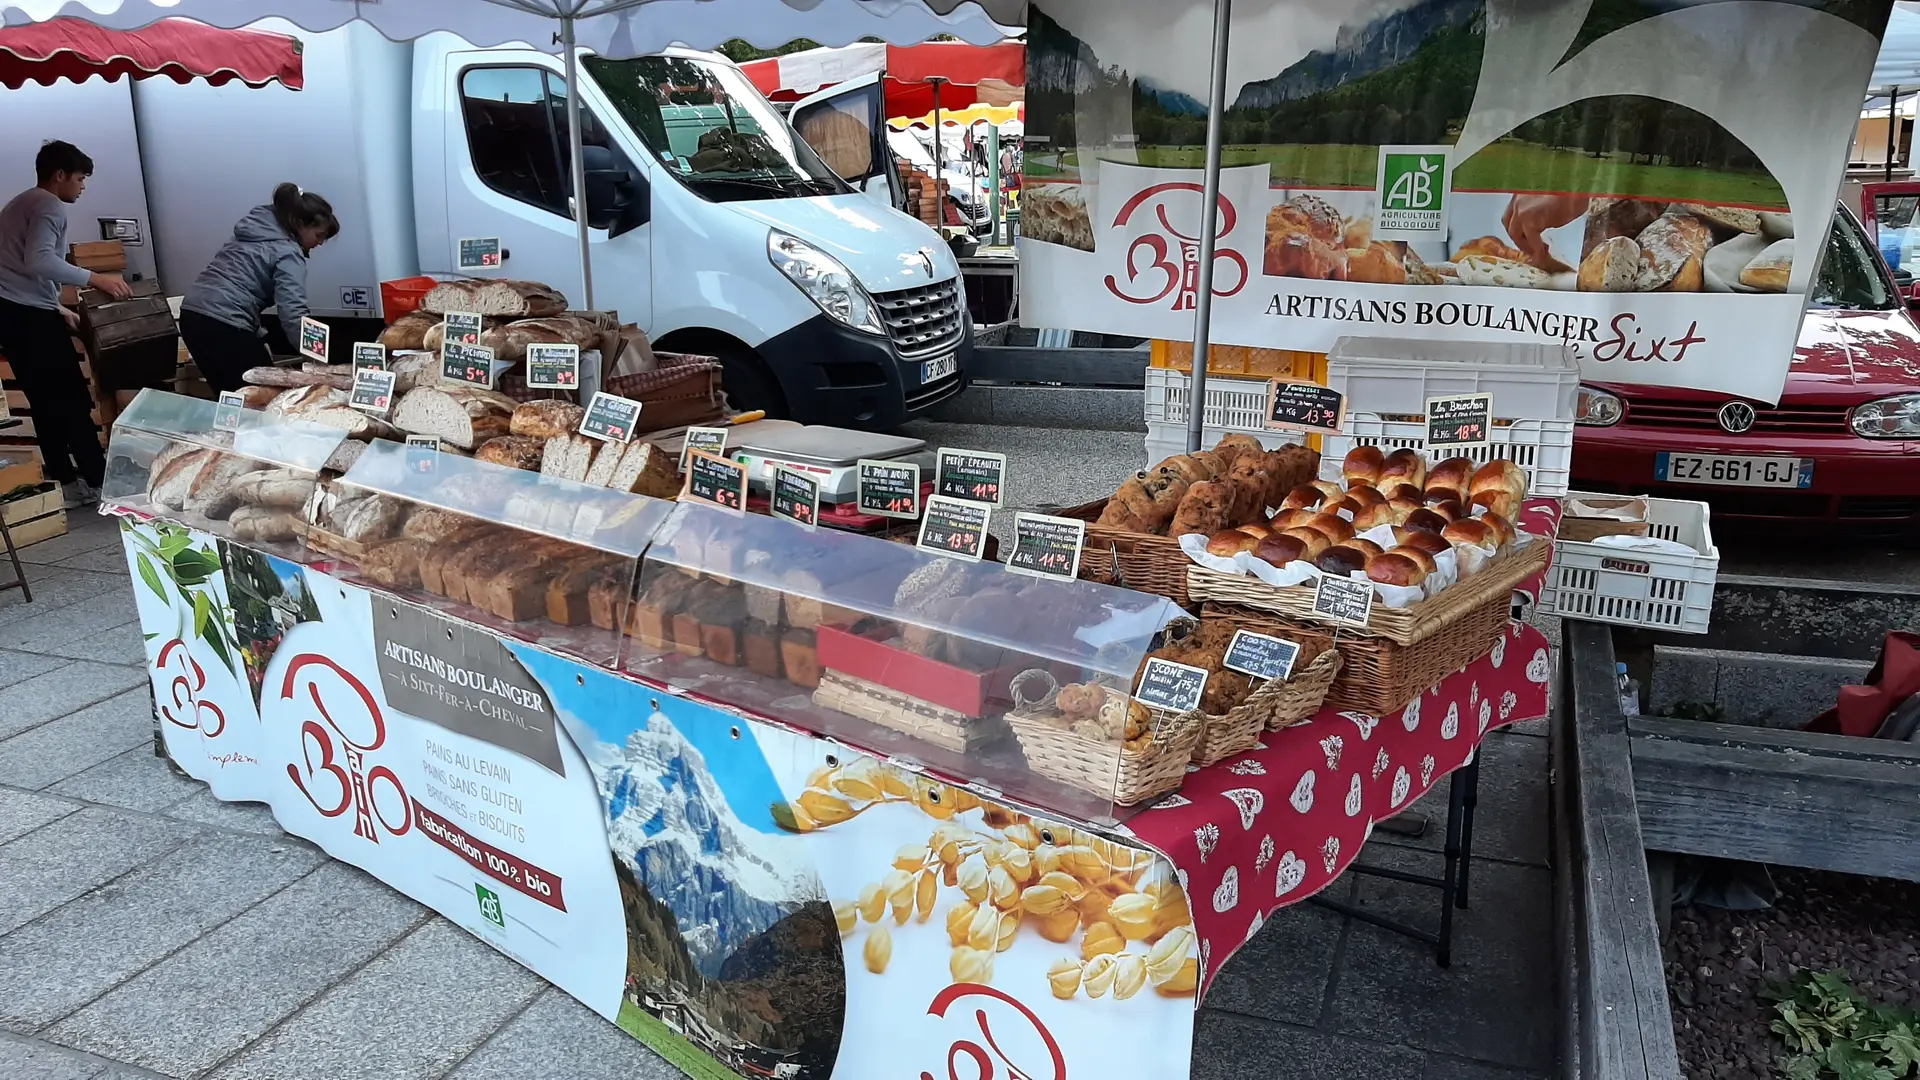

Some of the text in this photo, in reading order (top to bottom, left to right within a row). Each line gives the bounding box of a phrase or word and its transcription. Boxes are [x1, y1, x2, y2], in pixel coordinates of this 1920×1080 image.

[1386, 171, 1433, 207] AB
[1380, 220, 1440, 229] BIOLOGIQUE
[1381, 211, 1441, 220] AGRICULTURE
[1264, 293, 1600, 342] ARTISANS BOULANGER
[1593, 312, 1706, 362] Sixt
[1673, 457, 1794, 484] EZ-661-GJ
[1798, 473, 1811, 485] 74
[384, 639, 545, 713] ARTISANS BOULANGER
[426, 739, 511, 784] PAINS AU LEVAIN
[422, 760, 523, 815] PAINS SANS GLUTEN
[426, 783, 468, 819] BRIOCHES
[479, 810, 525, 844] BISCUITS
[420, 811, 552, 897] fabrication 100% bio
